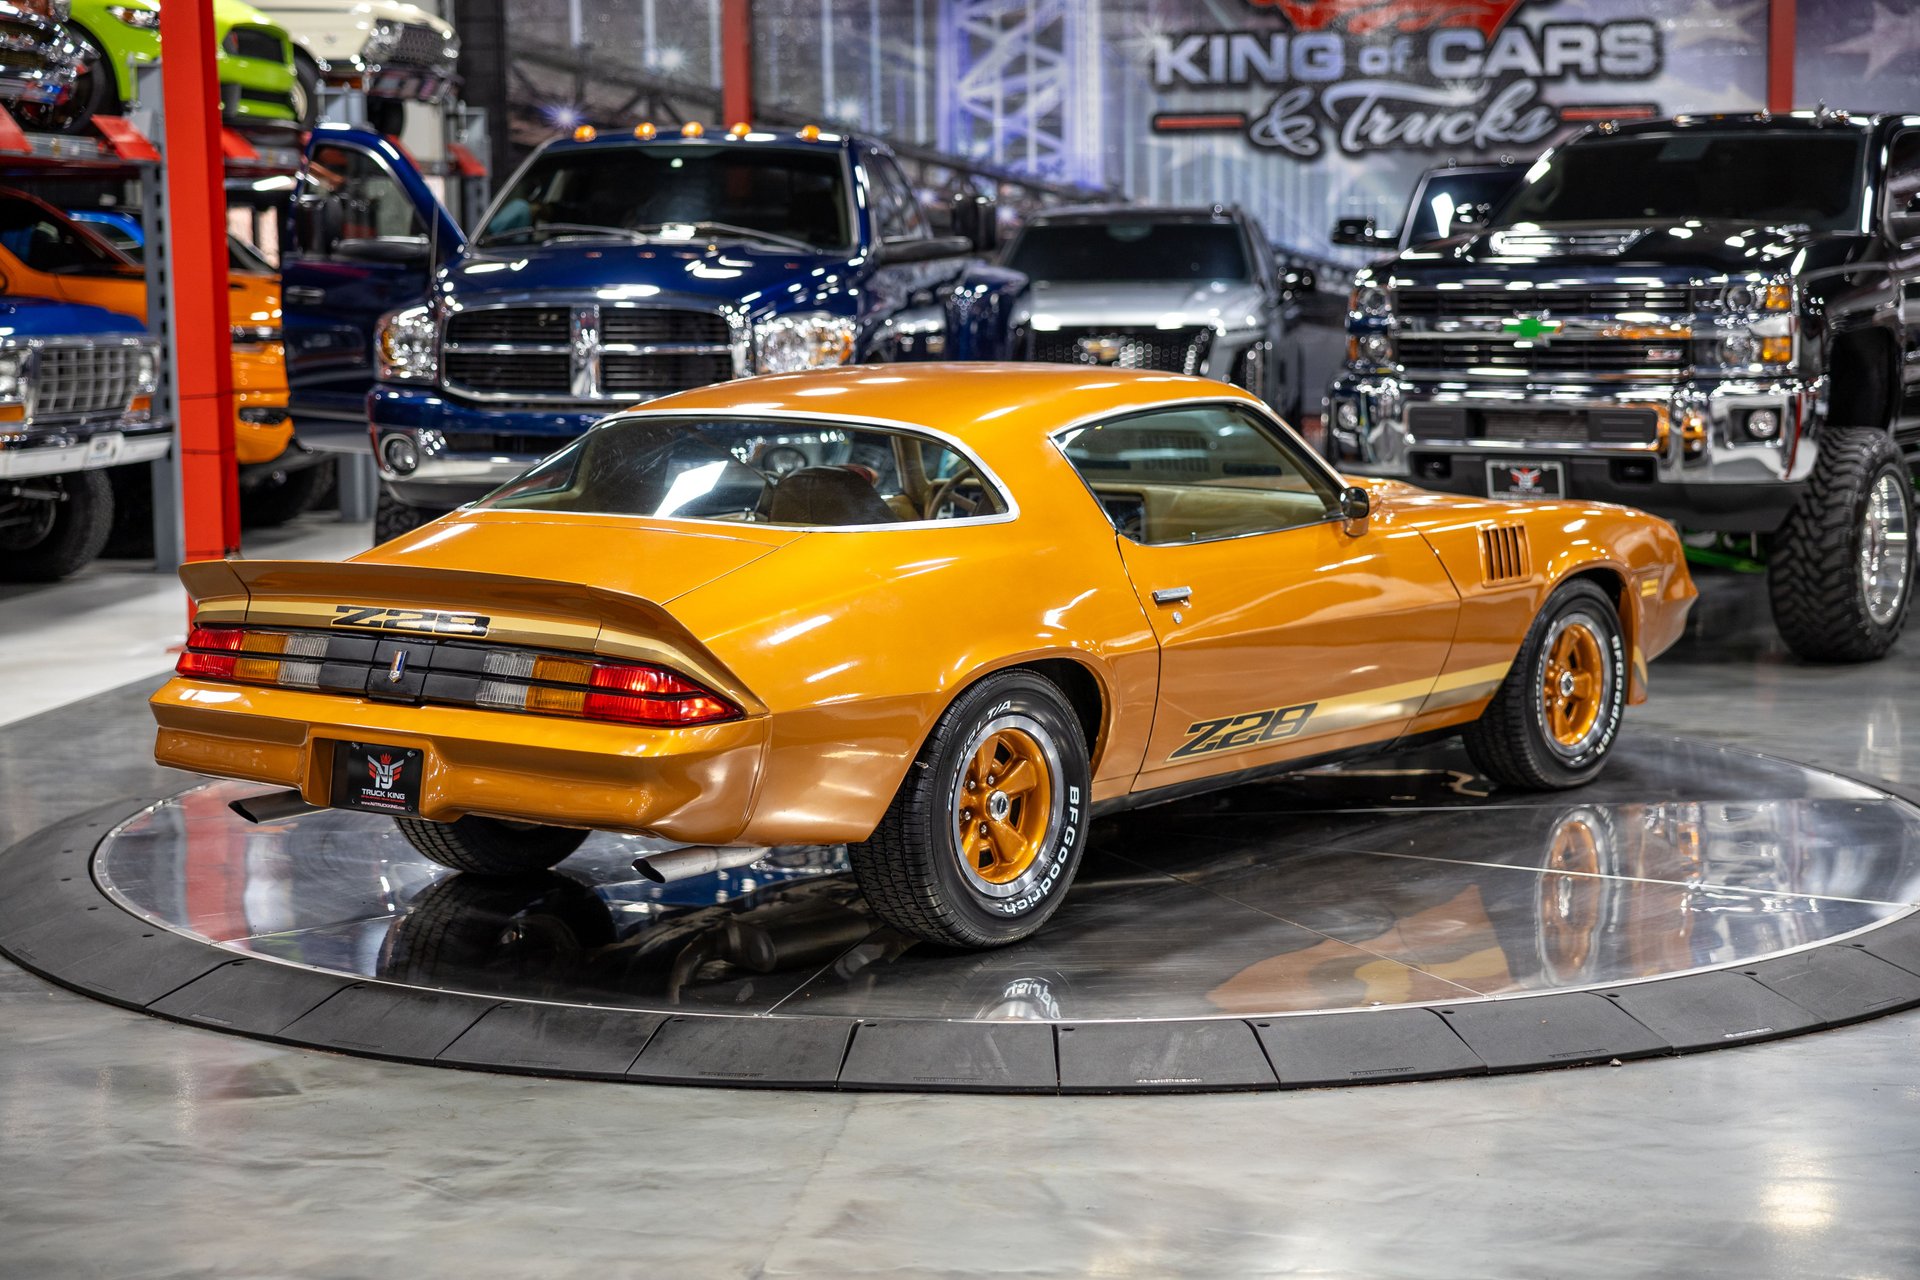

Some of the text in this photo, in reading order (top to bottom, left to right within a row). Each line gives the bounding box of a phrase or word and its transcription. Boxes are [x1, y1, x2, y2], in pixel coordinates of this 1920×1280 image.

[1154, 23, 1658, 84] KING of CARS
[1250, 79, 1556, 156] & Trucks
[332, 605, 490, 637] Z28
[987, 700, 1011, 719] T/A
[1166, 701, 1320, 761] Z28
[361, 788, 385, 797] TRUCK
[387, 792, 405, 800] KING
[1003, 785, 1080, 914] BFGoodrich
